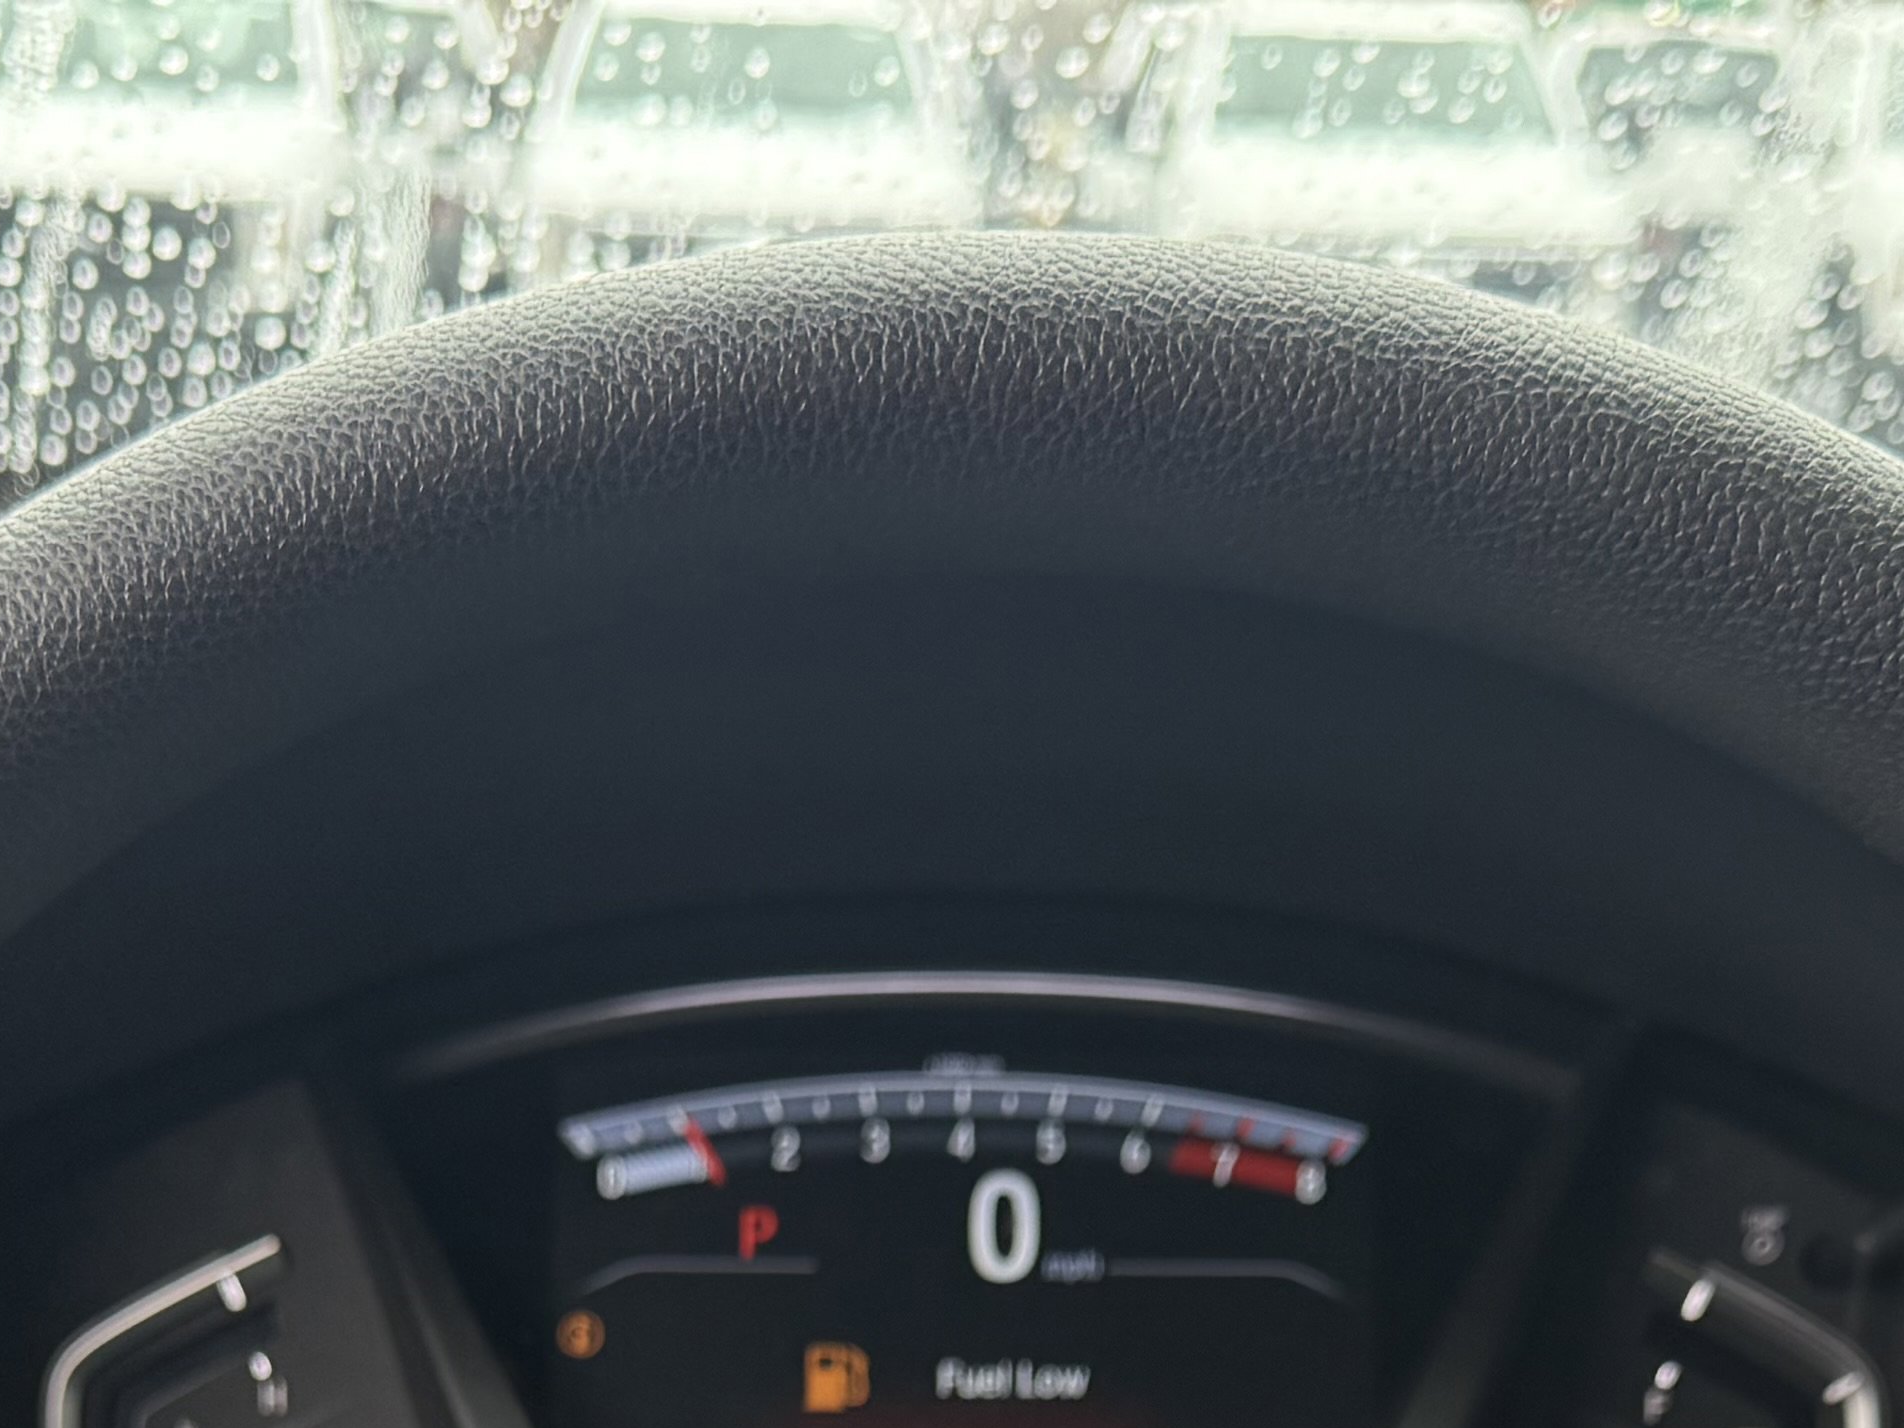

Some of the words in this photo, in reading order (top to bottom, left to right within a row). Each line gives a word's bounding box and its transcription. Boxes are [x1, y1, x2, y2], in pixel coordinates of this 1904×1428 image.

[770, 1124, 801, 1173] 2
[946, 1115, 977, 1164] 4
[1119, 1128, 1151, 1175] 6
[1210, 1141, 1241, 1188] 7
[738, 1204, 780, 1261] P
[967, 1166, 1041, 1285] 0
[935, 1356, 1013, 1400] Fuel
[1015, 1358, 1092, 1401] Low
